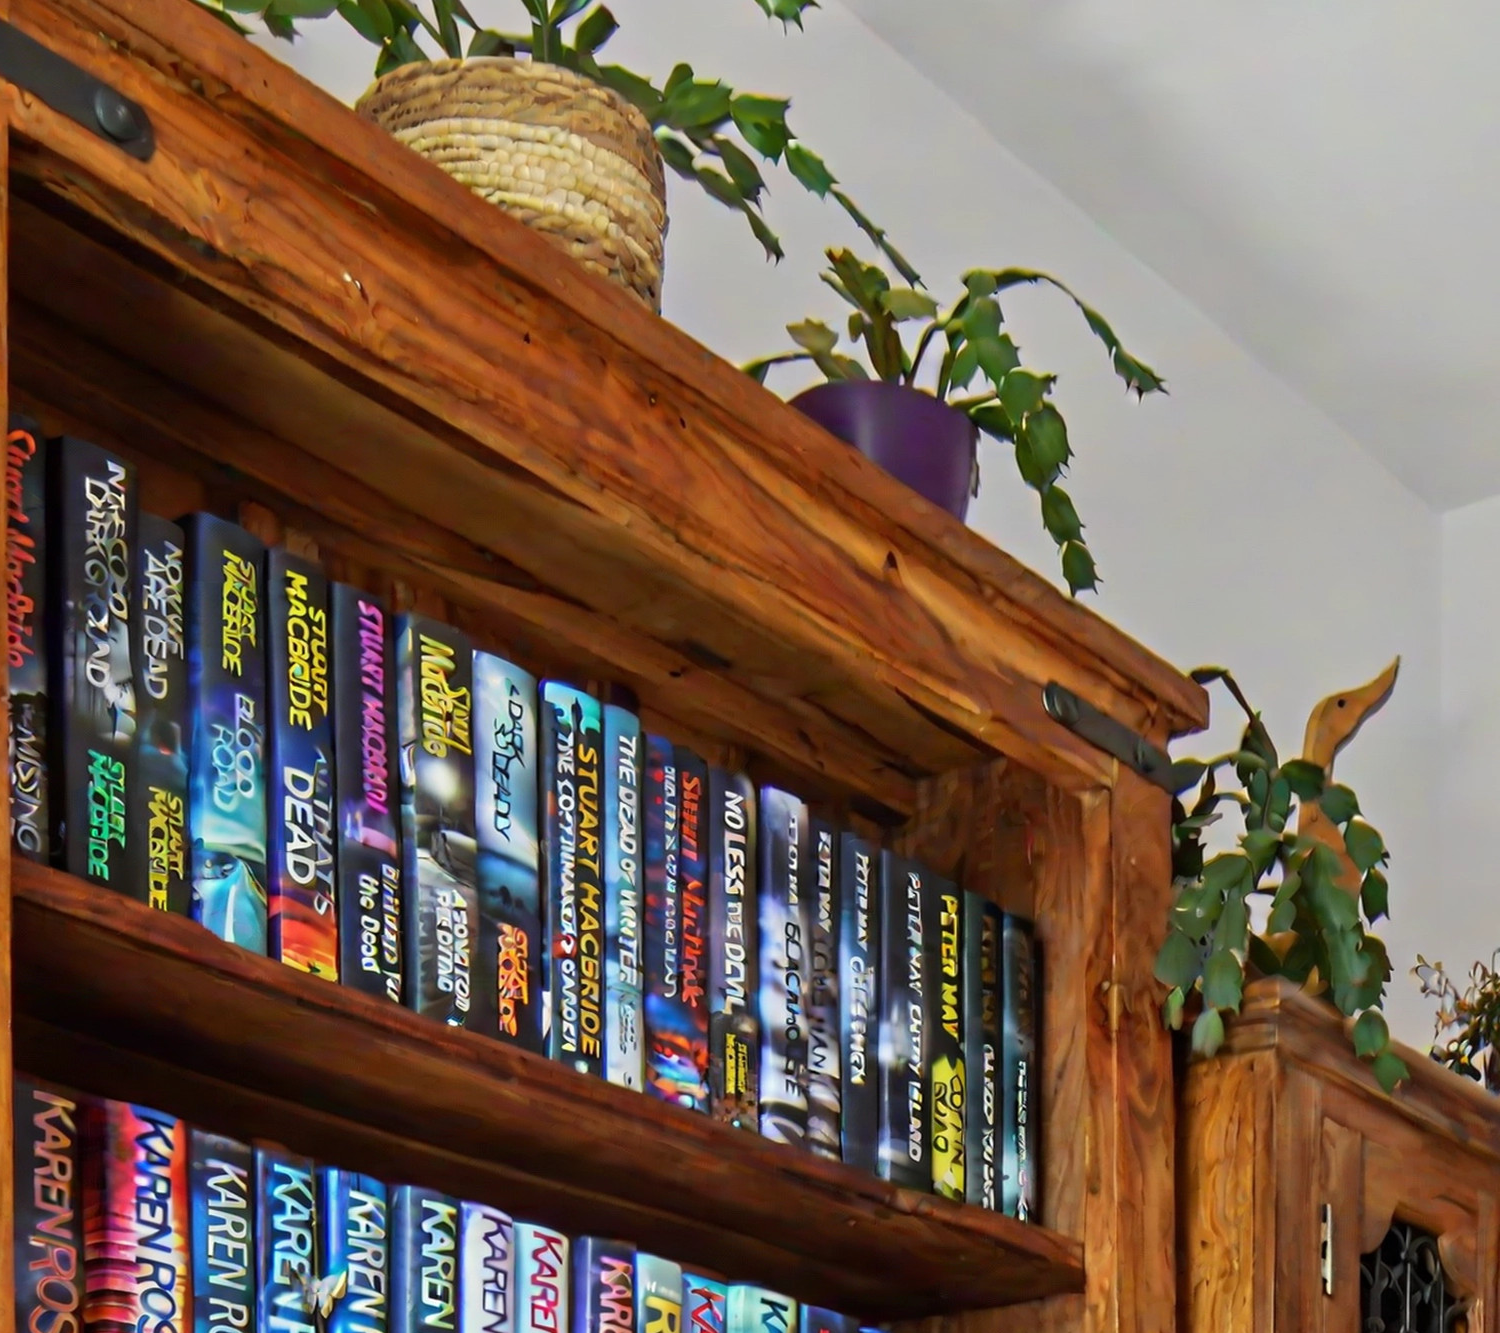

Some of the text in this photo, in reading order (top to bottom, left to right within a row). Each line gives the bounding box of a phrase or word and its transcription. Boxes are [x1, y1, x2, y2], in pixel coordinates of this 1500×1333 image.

[286, 570, 312, 732] MACBRIDE
[284, 765, 317, 885] DEAD
[576, 744, 600, 1056] STUART MACBRIDE
[940, 894, 959, 978] PETER
[32, 1091, 76, 1241] KAREN
[133, 1113, 176, 1262] KAREN
[206, 1158, 248, 1291] KAREN
[347, 1189, 386, 1315] KAREN
[421, 1200, 457, 1331] KAREN
